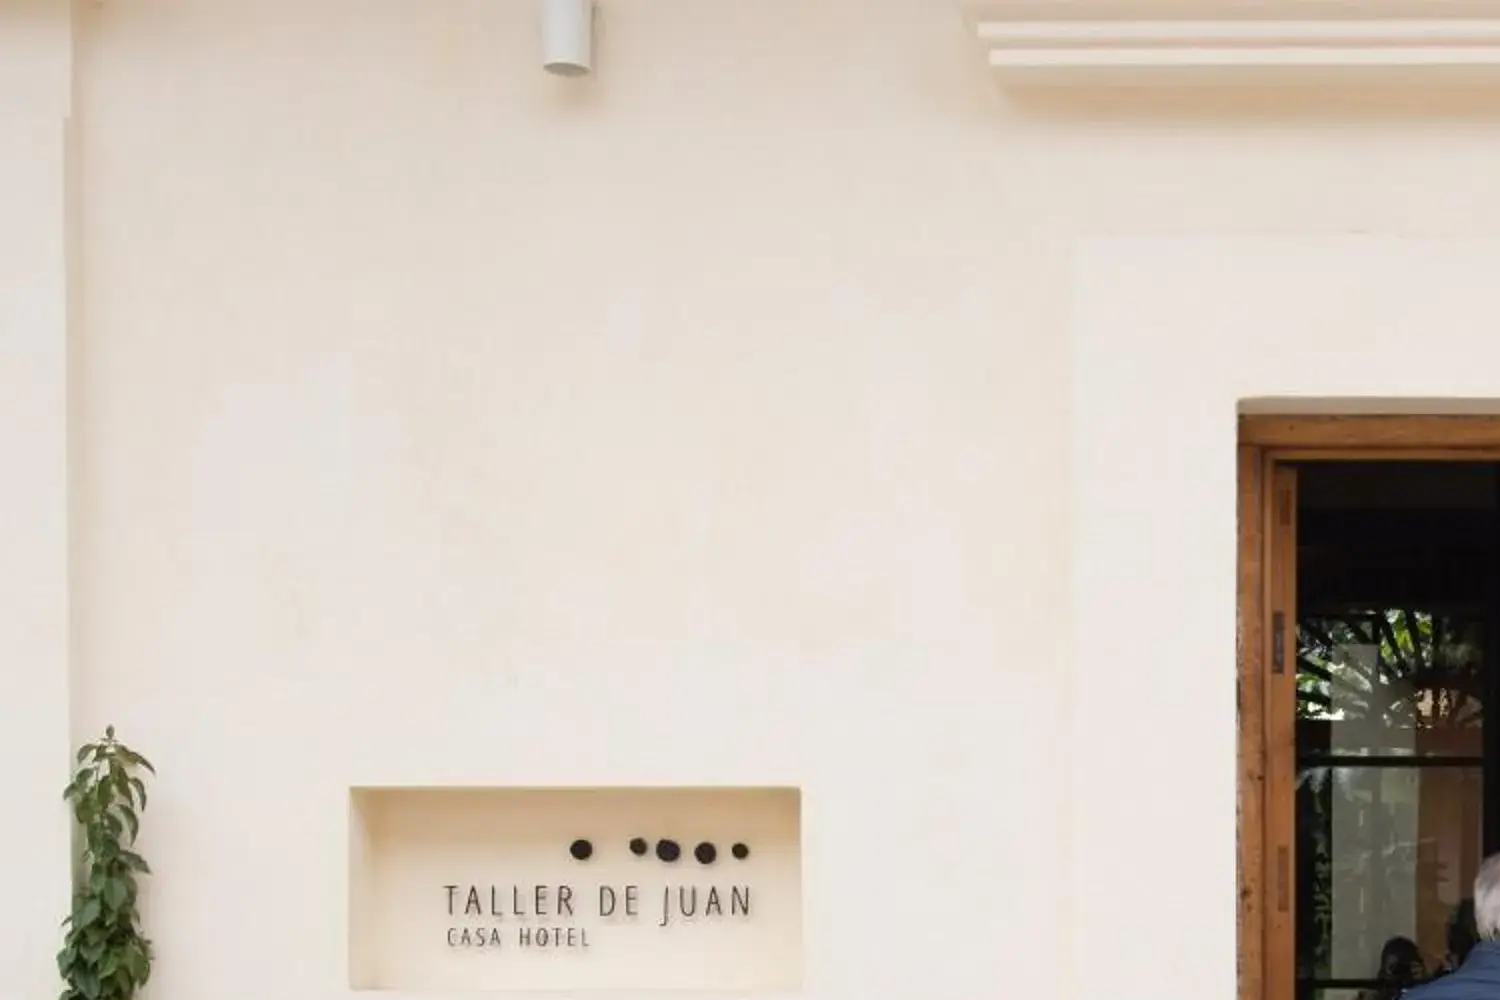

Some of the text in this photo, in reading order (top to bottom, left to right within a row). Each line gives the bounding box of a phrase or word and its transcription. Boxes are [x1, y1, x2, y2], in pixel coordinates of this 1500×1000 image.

[444, 885, 752, 926] TALLER DE JUAN
[447, 927, 590, 947] CASA HOTEL
